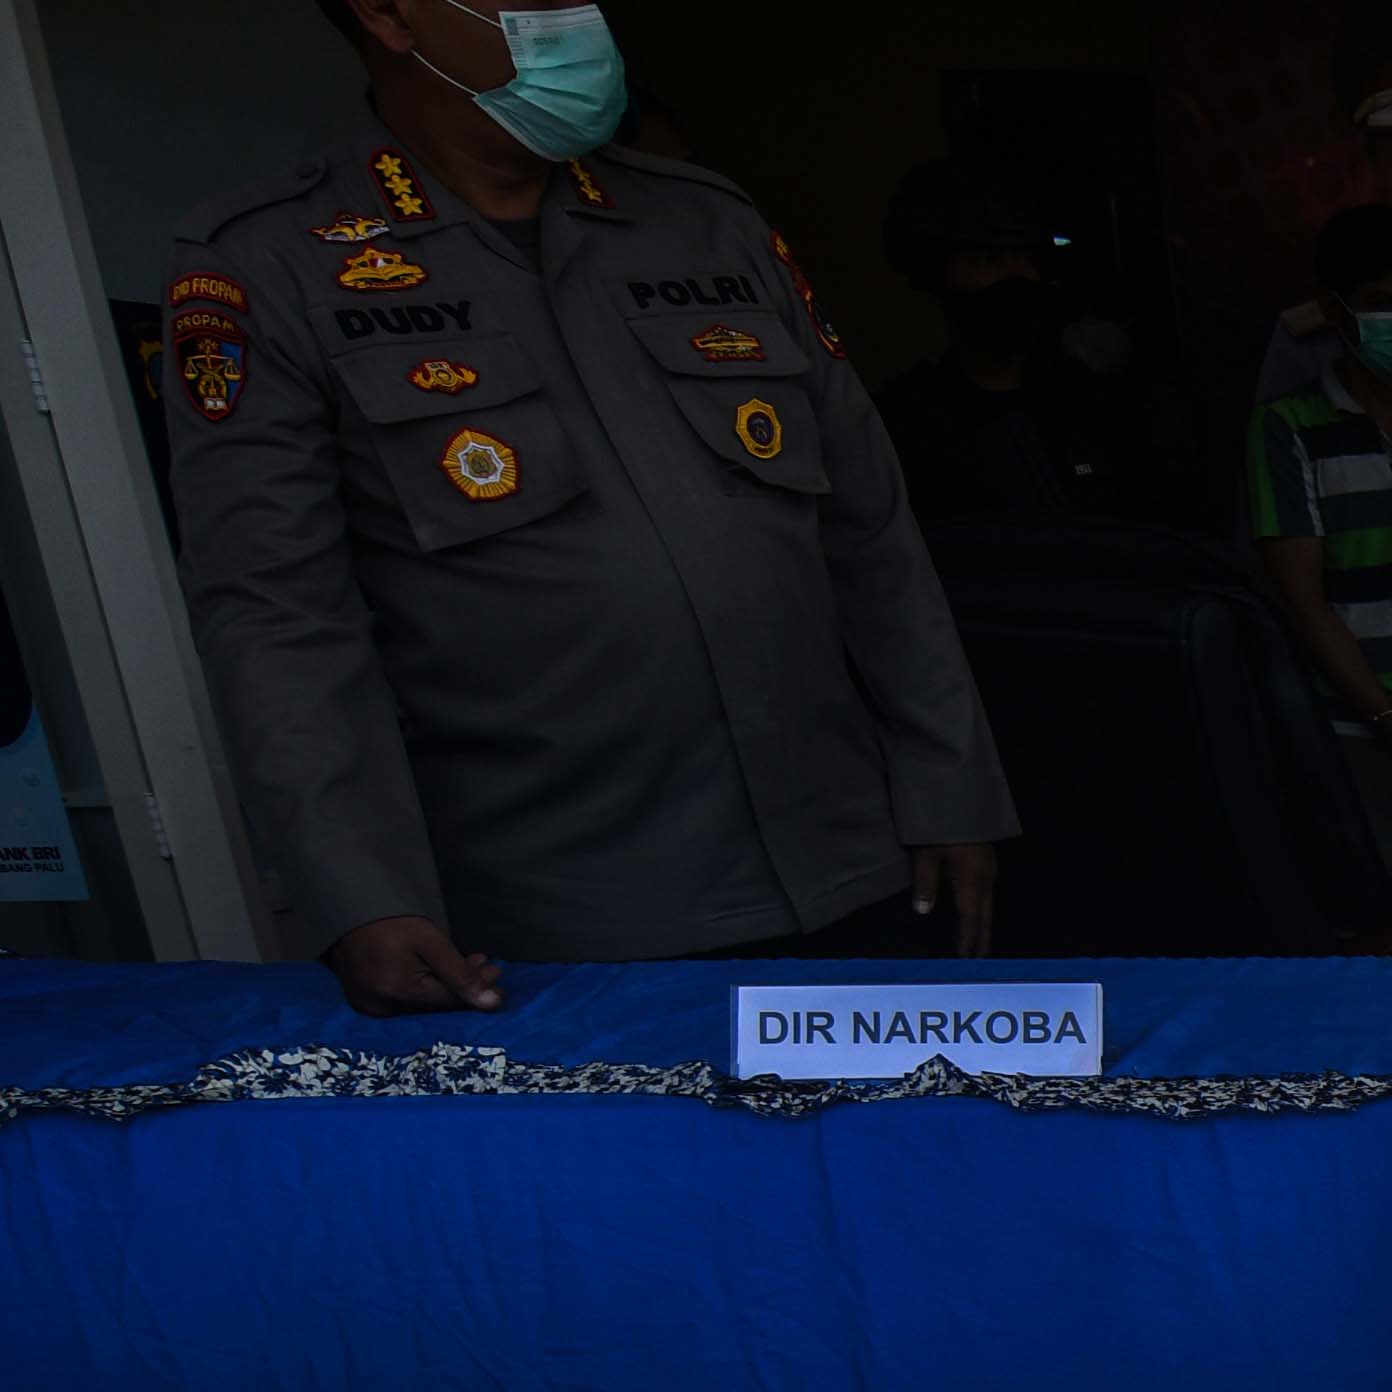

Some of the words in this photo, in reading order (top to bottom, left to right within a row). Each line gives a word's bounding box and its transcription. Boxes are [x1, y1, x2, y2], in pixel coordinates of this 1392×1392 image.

[628, 275, 759, 308] POLRI
[334, 301, 472, 340] DUDY
[759, 1010, 836, 1045] DIR
[852, 1009, 1088, 1045] NARKOBA
